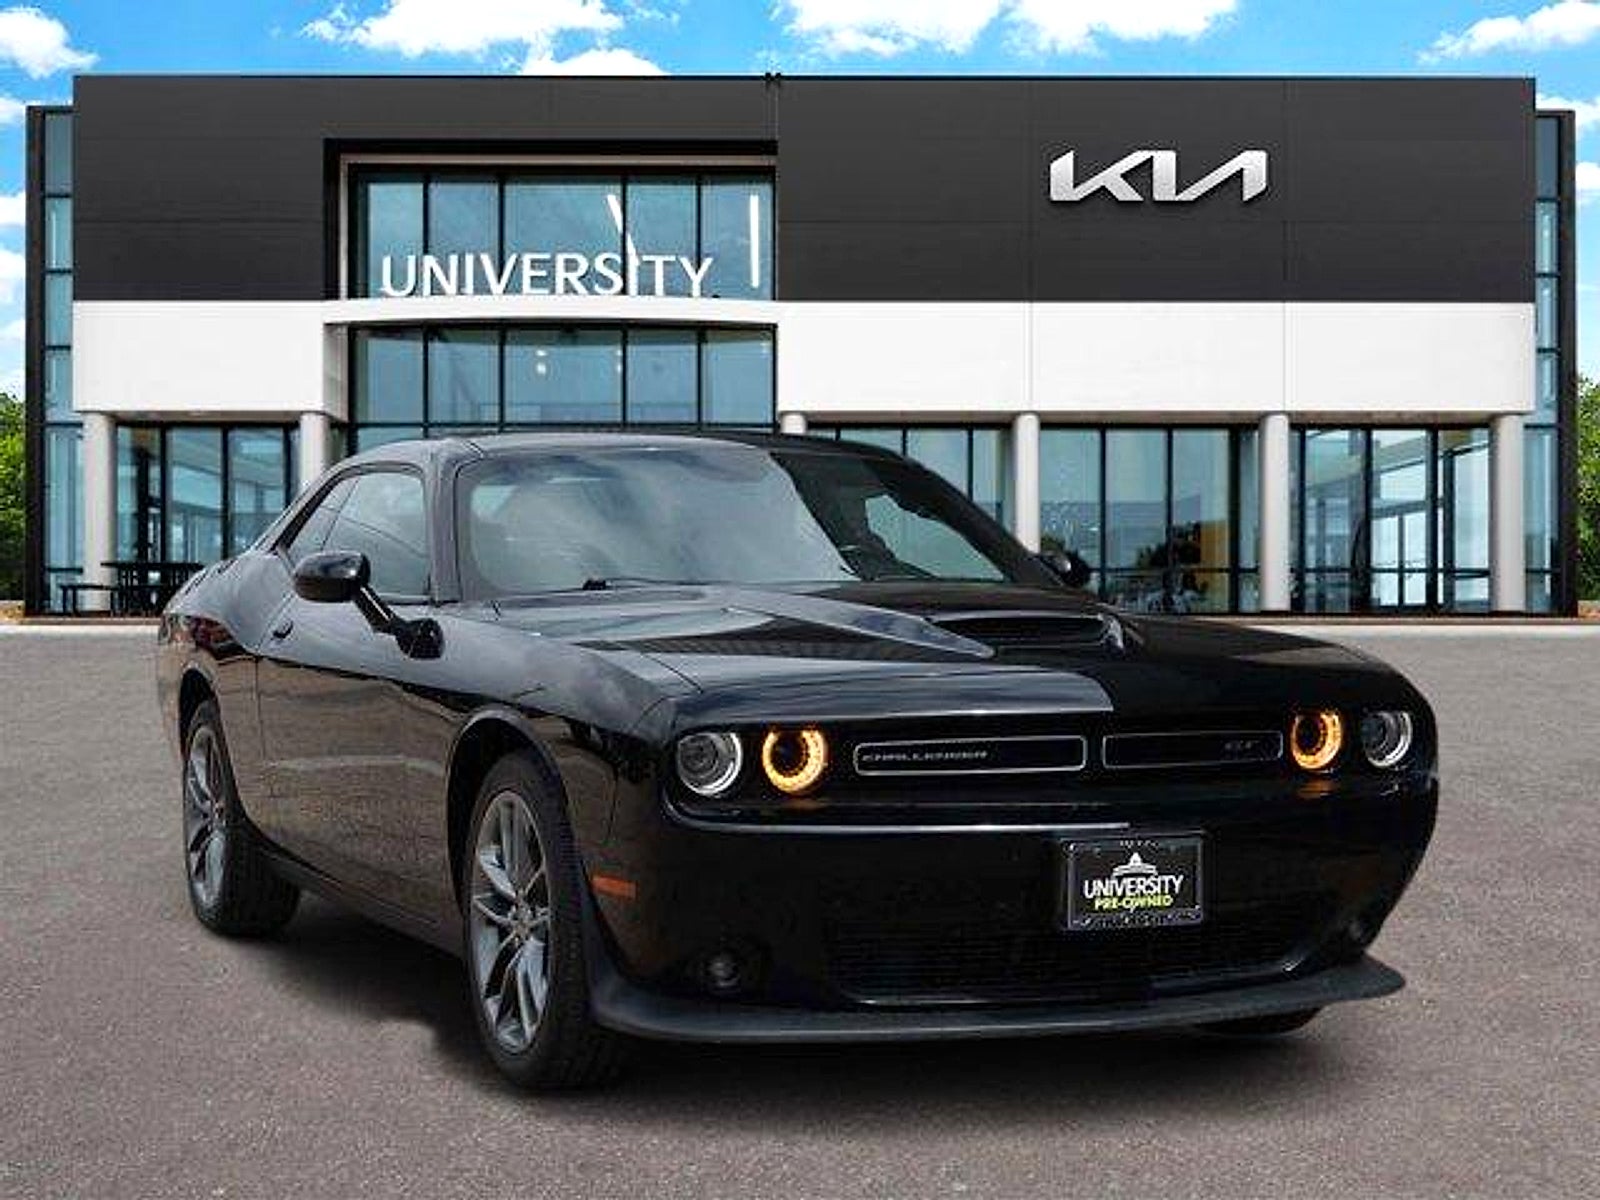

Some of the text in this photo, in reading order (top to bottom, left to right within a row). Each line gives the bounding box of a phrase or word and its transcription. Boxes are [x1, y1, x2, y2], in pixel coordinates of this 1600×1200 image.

[1049, 149, 1268, 202] KIA
[380, 252, 714, 297] UNIVERSITY
[1083, 874, 1184, 899] UNIVERSITY
[1094, 894, 1174, 911] PRE-OWNED
